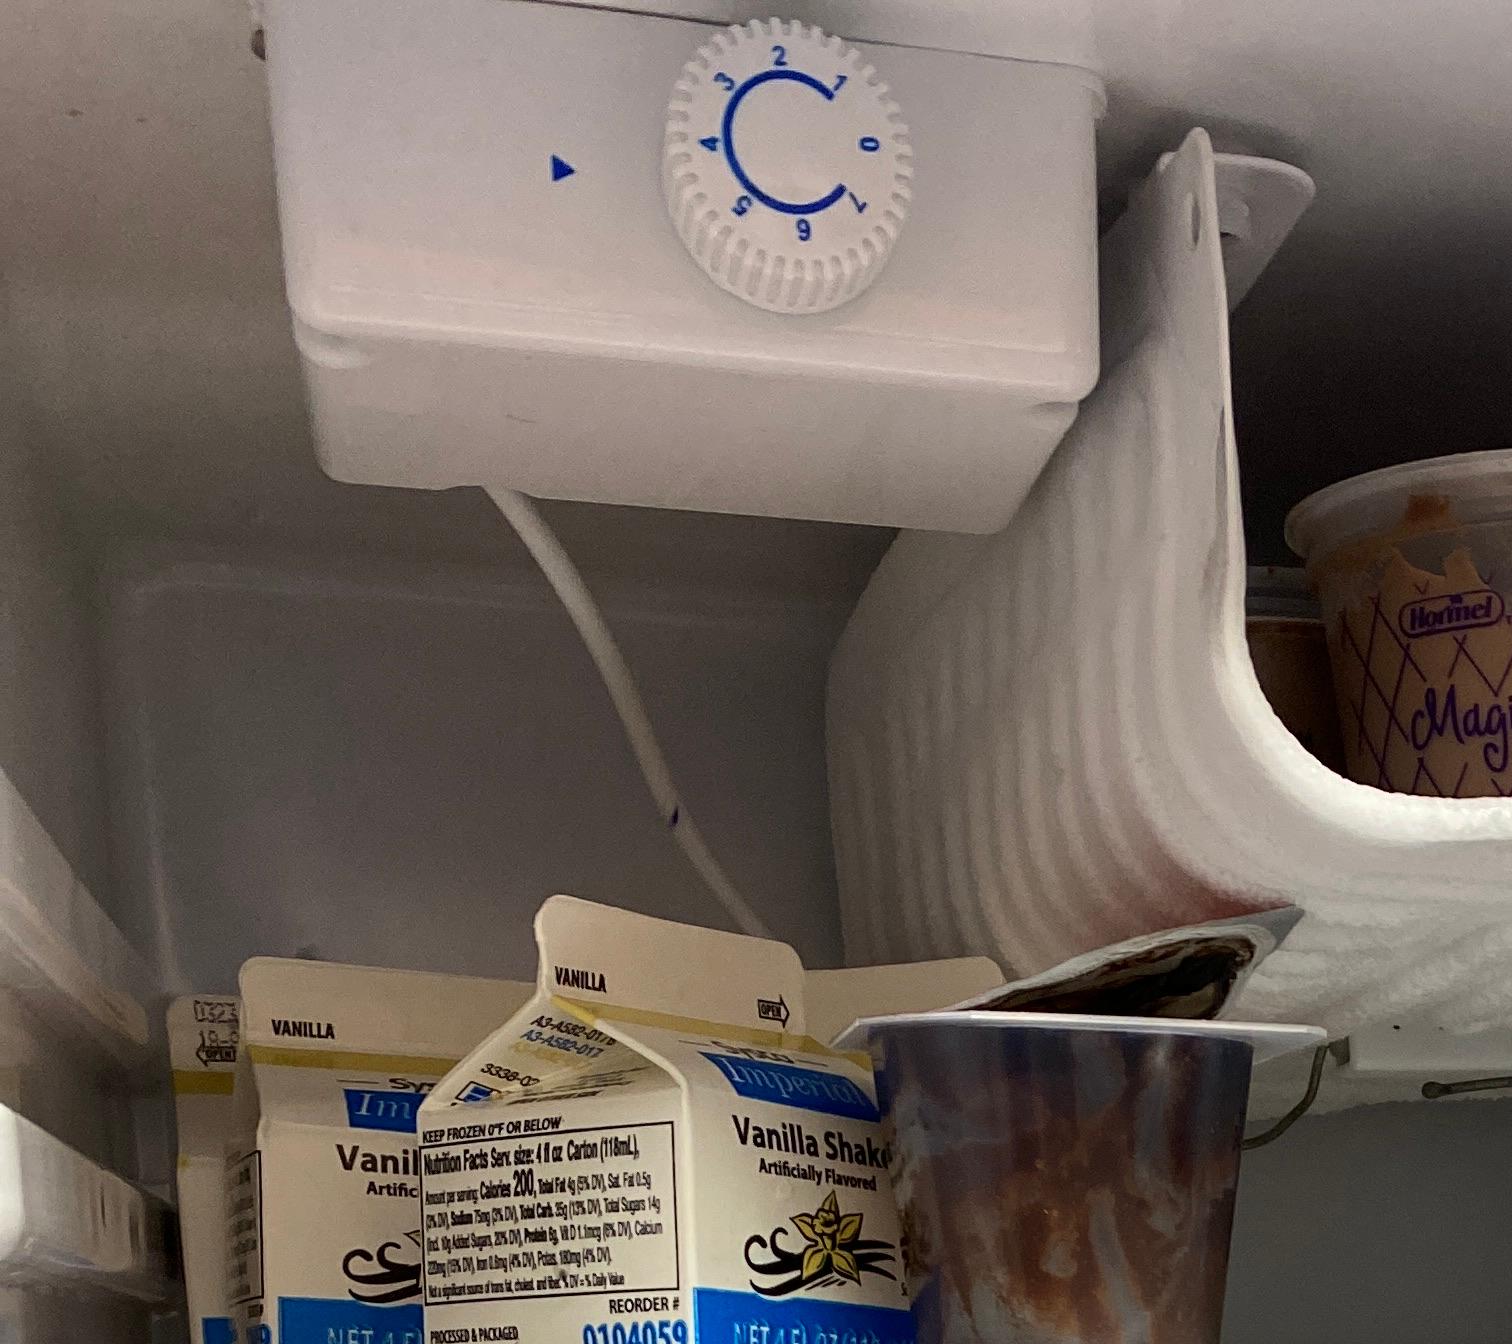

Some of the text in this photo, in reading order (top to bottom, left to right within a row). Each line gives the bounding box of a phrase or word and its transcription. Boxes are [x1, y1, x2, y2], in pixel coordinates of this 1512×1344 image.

[772, 45, 788, 66] 2
[713, 71, 736, 91] 3
[833, 74, 848, 92] 1
[698, 135, 720, 152] 4
[858, 135, 881, 153] 0
[731, 194, 753, 217] 5
[848, 191, 867, 214] 7
[796, 218, 811, 242] 6
[1409, 596, 1493, 631] Hormel
[554, 964, 608, 994] VANILLA
[759, 1001, 783, 1019] OPEN
[271, 1018, 336, 1041] VANILLA
[206, 1047, 236, 1062] OPEN
[422, 1116, 562, 1144] KEEP FROZEN OR BELOW
[732, 1114, 819, 1160] Vanilla
[424, 1138, 598, 1177] Nutrition Facts Carton
[479, 1179, 512, 1201] Calories
[513, 1167, 537, 1199] 200,
[758, 1157, 877, 1192] Artificially Flavored
[366, 1180, 418, 1198] Artific
[608, 1297, 670, 1315] REORDER
